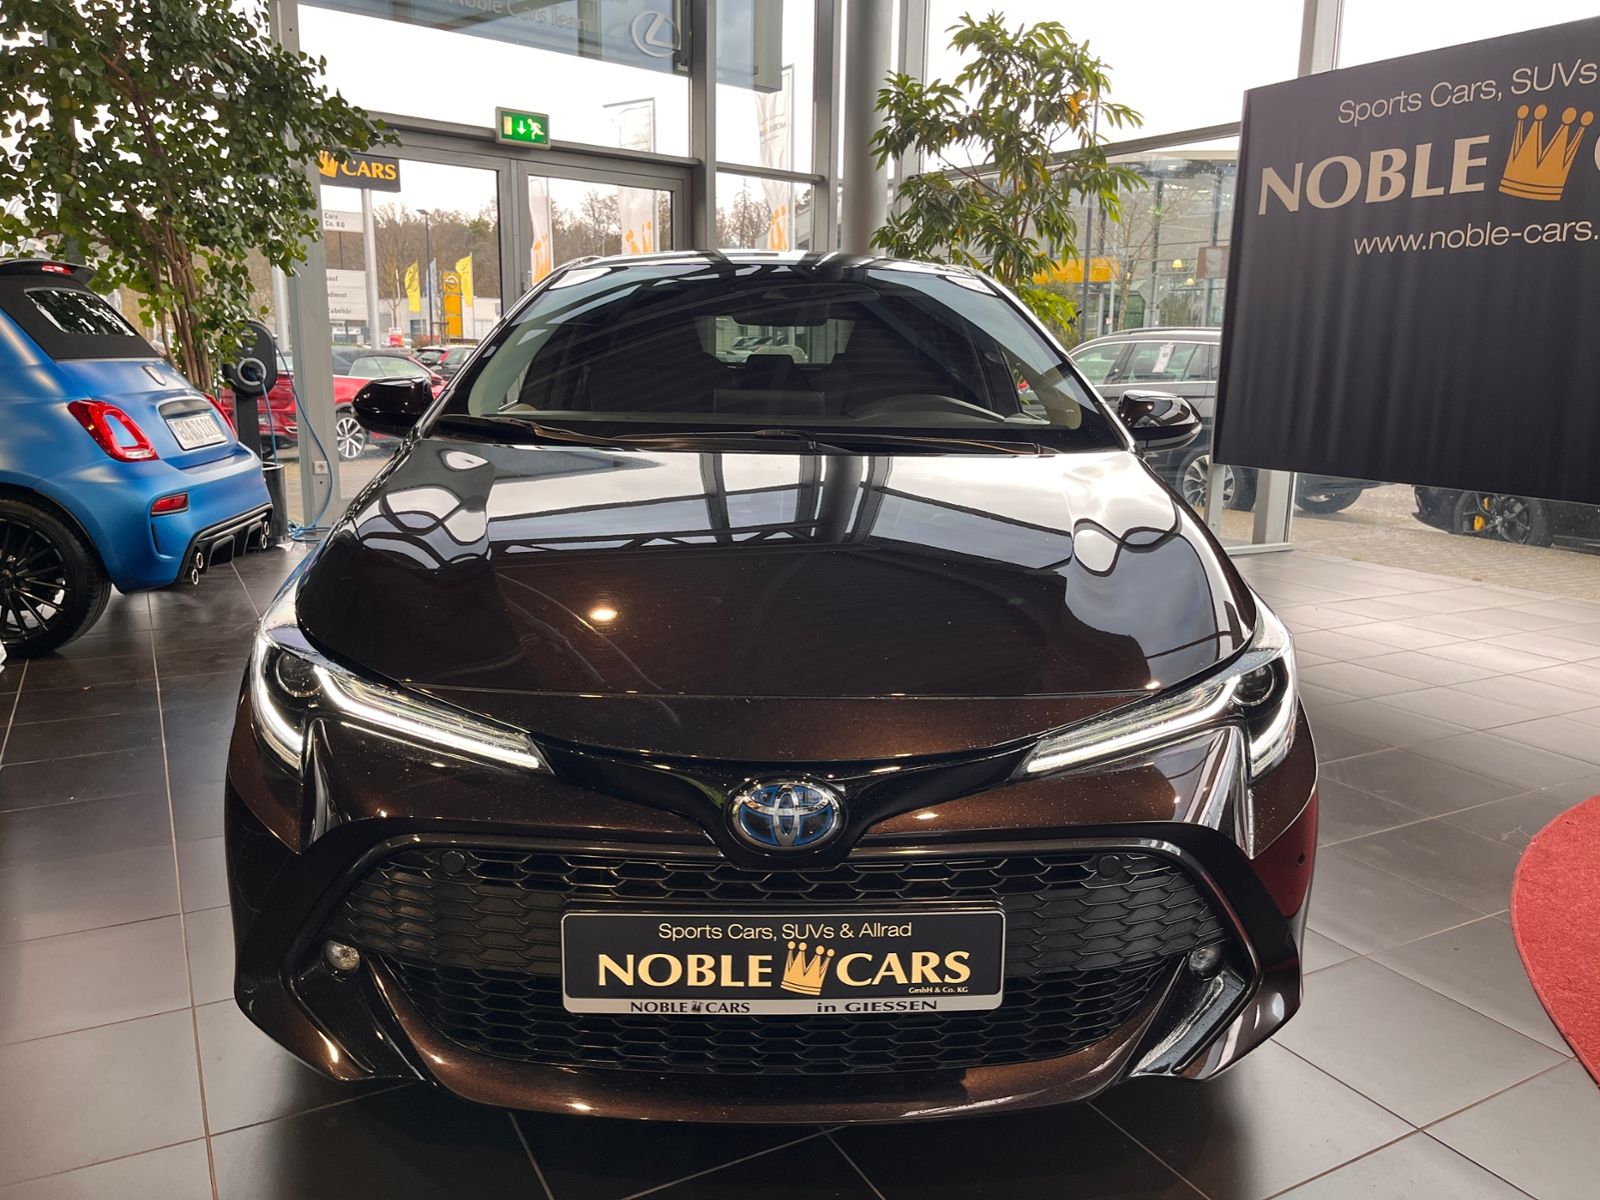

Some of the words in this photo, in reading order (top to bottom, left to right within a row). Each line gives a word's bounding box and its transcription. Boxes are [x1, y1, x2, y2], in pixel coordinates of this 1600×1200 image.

[1337, 90, 1422, 126] Sports
[1430, 79, 1502, 108] Cars,
[1510, 58, 1598, 95] SUVs
[341, 160, 397, 181] CARS
[1257, 134, 1491, 216] NOBLE
[658, 922, 723, 942] Sports
[727, 922, 777, 942] Cars,
[781, 923, 835, 940] SUVs
[839, 922, 854, 938] &
[858, 921, 912, 938] Allrad
[597, 953, 773, 988] NOBLE
[835, 950, 971, 987] CARS
[908, 986, 933, 994] GmbH
[942, 986, 955, 994] Co.
[630, 1000, 689, 1013] NOBLE
[705, 1001, 751, 1013] CARS
[817, 1002, 836, 1013] in
[844, 1000, 938, 1013] GIESSEN
